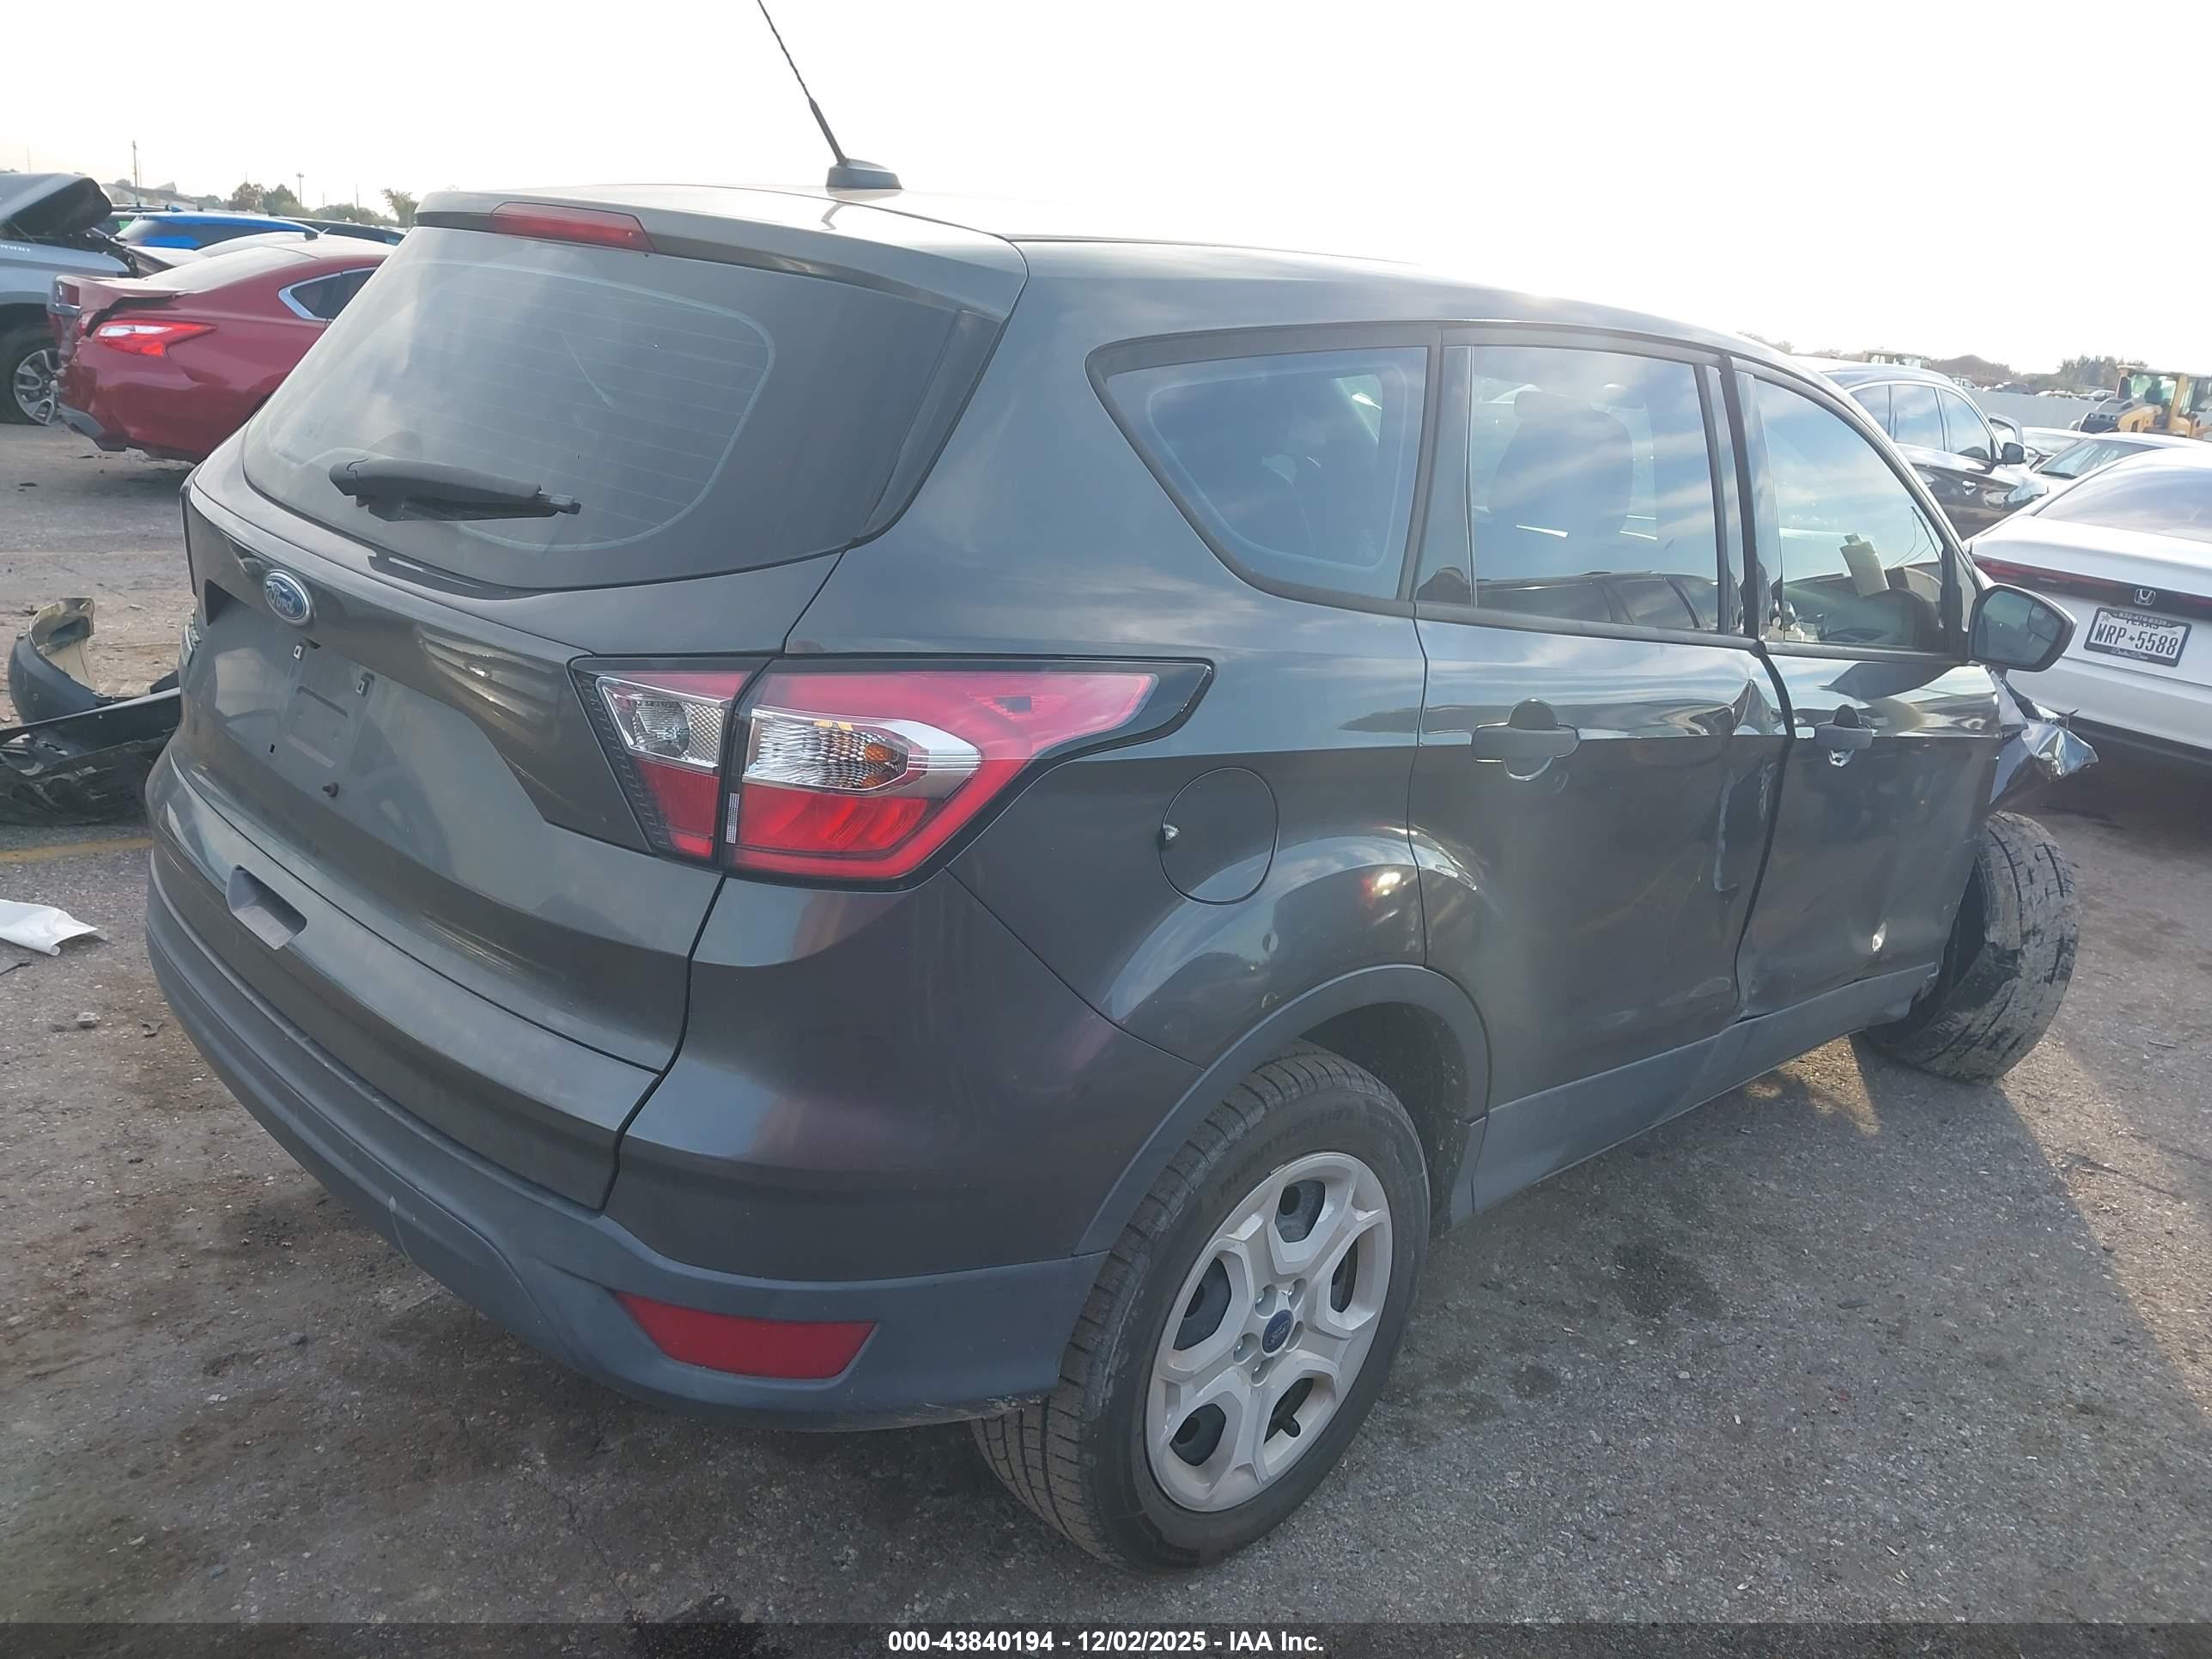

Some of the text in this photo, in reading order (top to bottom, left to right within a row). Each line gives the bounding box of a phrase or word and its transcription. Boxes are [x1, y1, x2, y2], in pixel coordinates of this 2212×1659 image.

[266, 580, 296, 615] Ford
[2095, 623, 2127, 645] WRP
[2135, 631, 2179, 656] 5588
